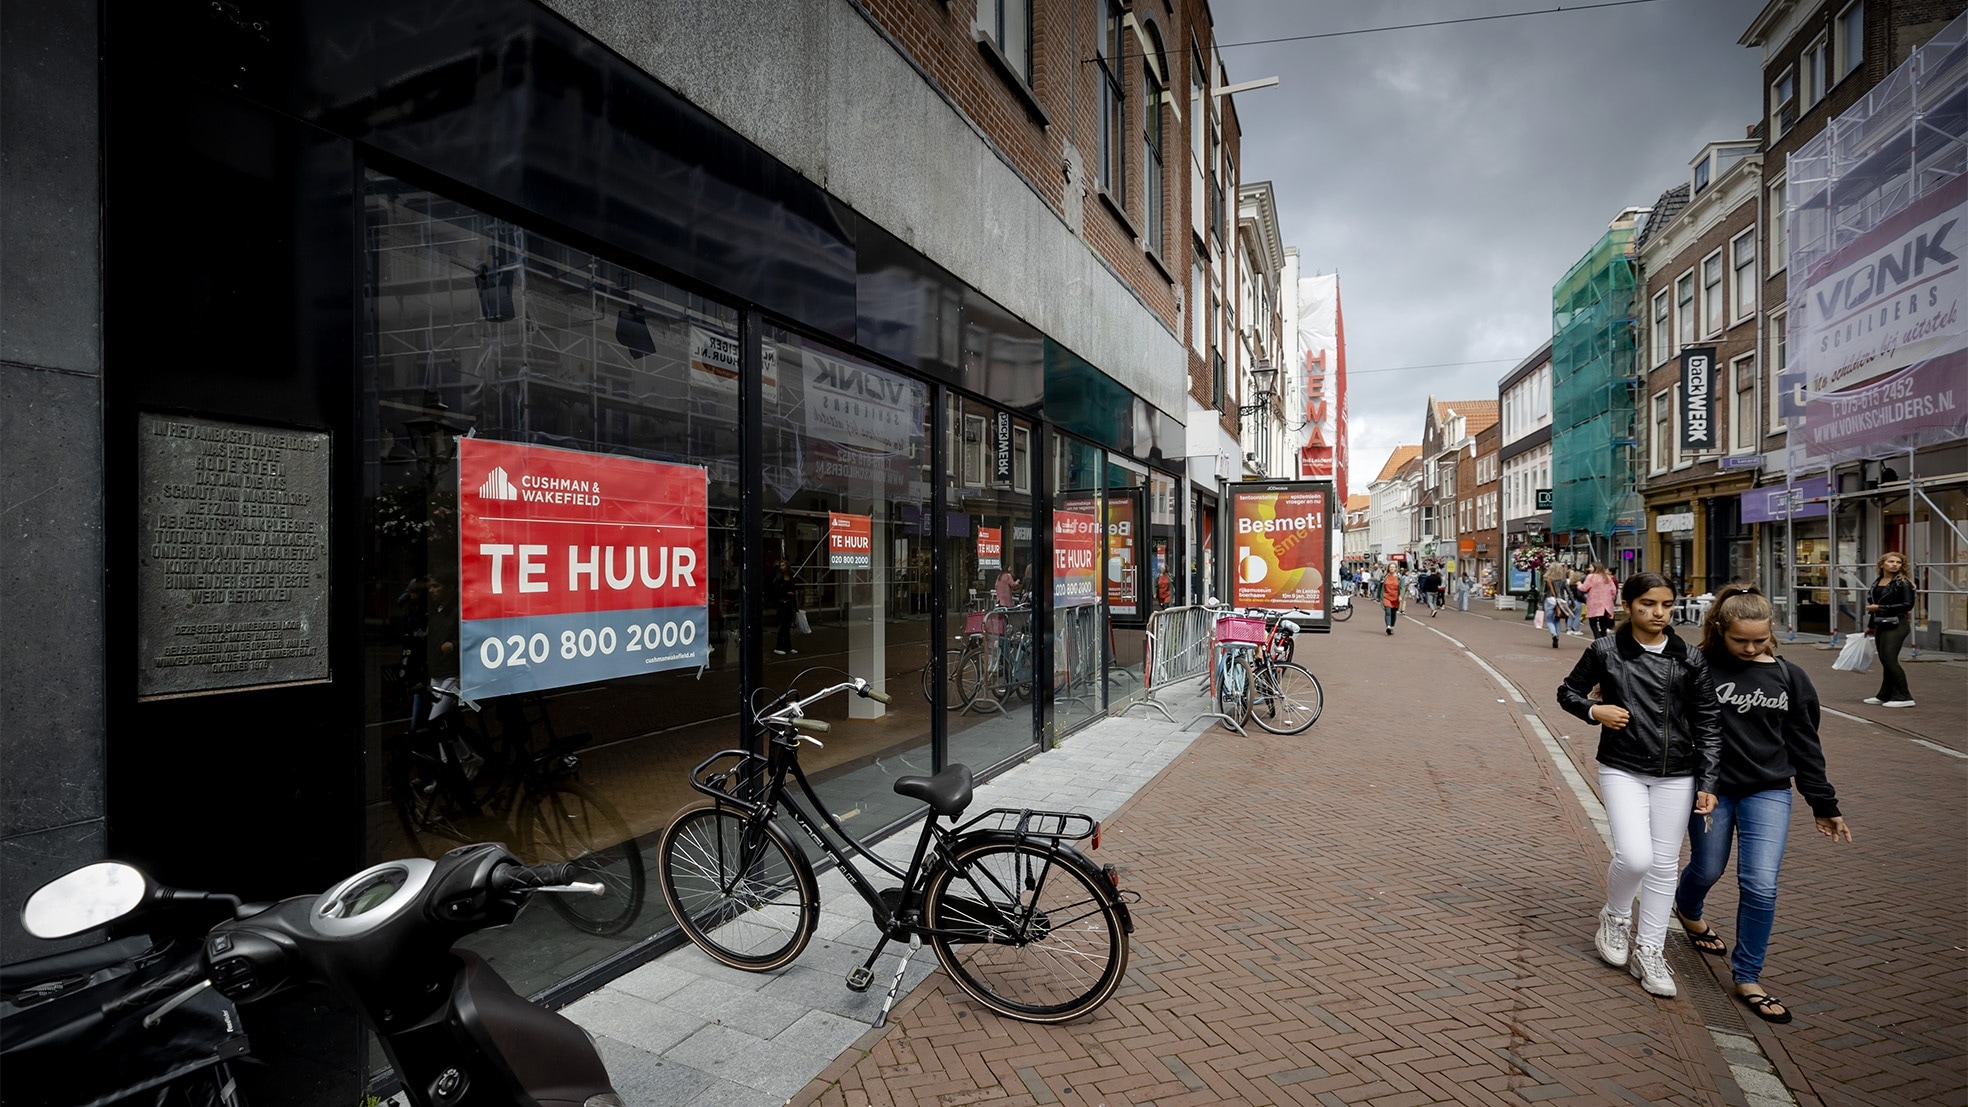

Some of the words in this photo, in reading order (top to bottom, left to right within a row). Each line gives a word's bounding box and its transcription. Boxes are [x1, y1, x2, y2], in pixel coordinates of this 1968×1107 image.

[1816, 217, 1959, 322] VONK
[1821, 286, 1938, 352] SCHILDERS
[1902, 299, 1958, 346] uitstek
[1306, 348, 1328, 449] HEMA
[1688, 356, 1708, 443] backWERK
[1813, 389, 1956, 443] WWW.VONKSCHILDERS.NL
[1831, 401, 1840, 418] T:
[1882, 378, 1914, 403] 2452
[521, 475, 588, 492] CUSHMAN
[592, 481, 601, 493] &
[521, 489, 601, 506] WAKEFIELD
[832, 535, 843, 548] TE
[844, 535, 869, 549] HUUR
[1238, 512, 1323, 534] Besmet!
[479, 543, 549, 595] TE
[568, 545, 697, 592] HUUR
[831, 555, 843, 564] 020
[843, 556, 855, 564] 800
[855, 556, 869, 565] 2000
[978, 543, 986, 553] TE
[986, 544, 1000, 554] HUUR
[1055, 549, 1067, 569] TE
[1068, 549, 1092, 569] HUUR
[479, 632, 551, 670] 020
[560, 626, 617, 660] 800
[626, 620, 697, 652] 2000
